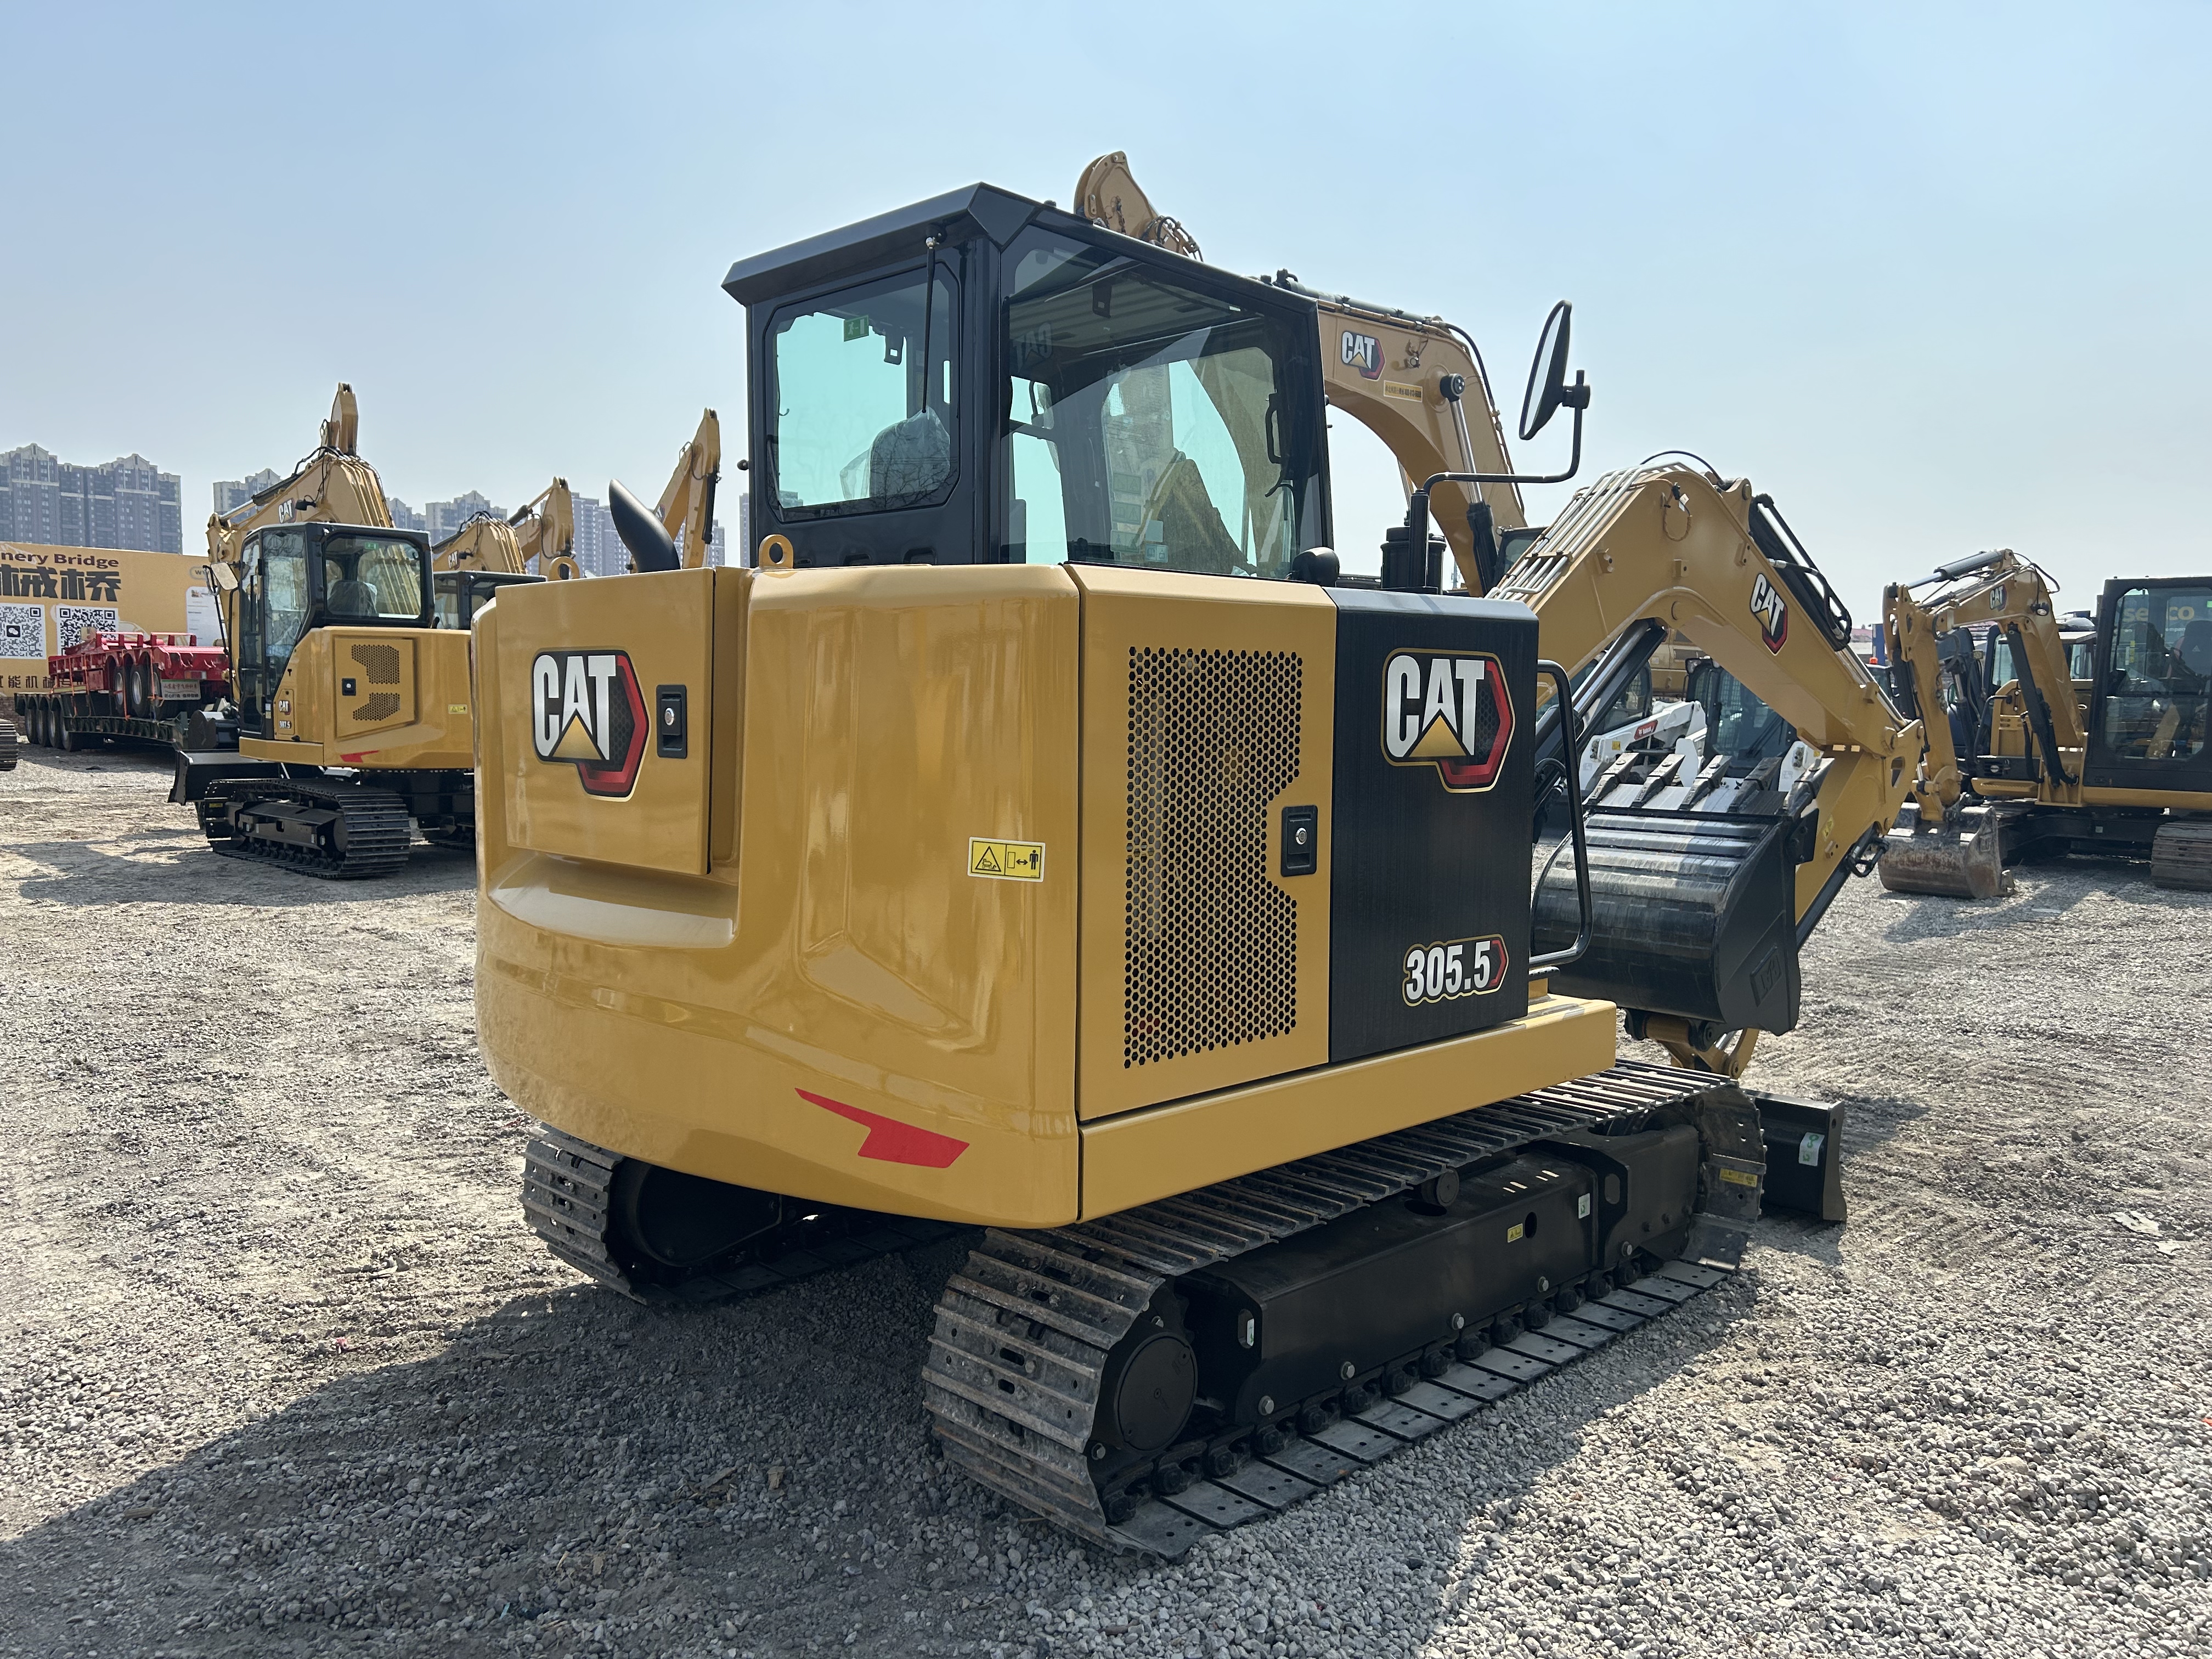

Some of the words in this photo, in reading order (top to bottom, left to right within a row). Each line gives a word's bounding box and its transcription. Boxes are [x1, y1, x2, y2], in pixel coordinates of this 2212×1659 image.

[1342, 331, 1375, 369] CAT
[278, 499, 292, 523] CAT
[1, 552, 48, 565] nery
[54, 554, 119, 569] Bridge
[448, 551, 457, 569] CAT
[1751, 574, 1785, 636] CAT
[1990, 585, 2003, 609] CAT
[279, 701, 289, 712] CAT
[533, 654, 616, 760] CAT
[1386, 655, 1485, 758] CAT
[1406, 940, 1491, 1000] 305.5
